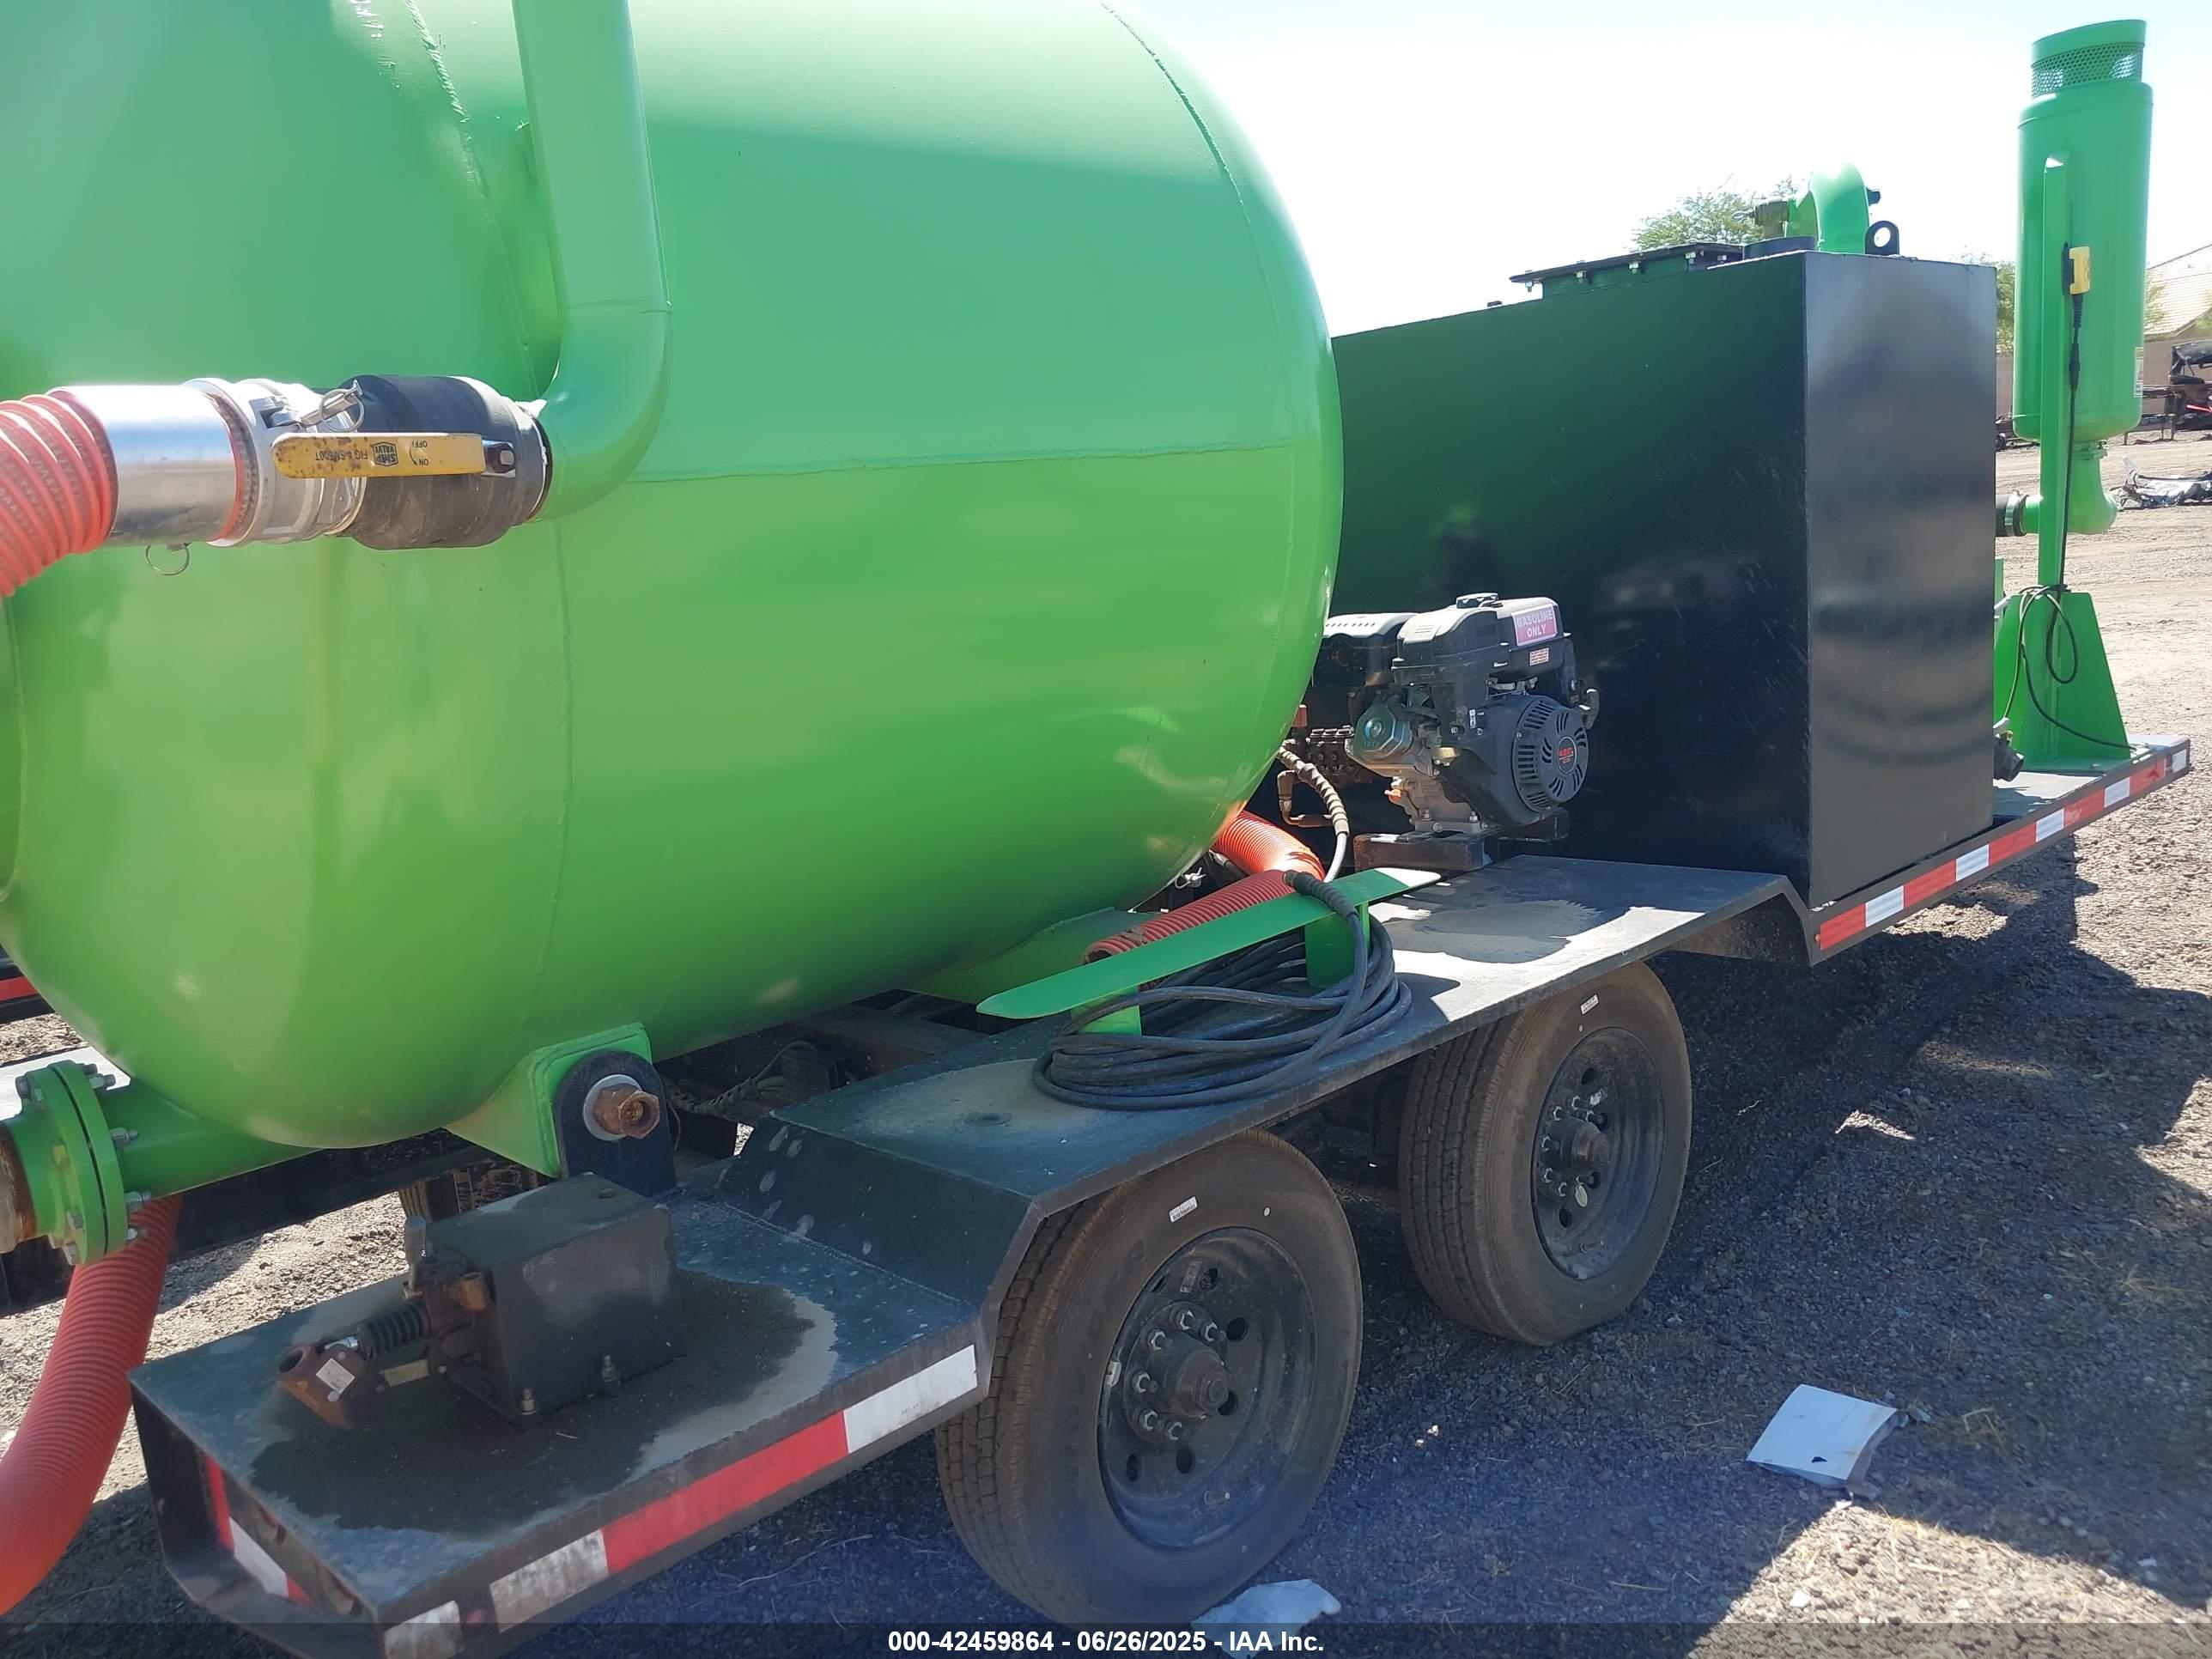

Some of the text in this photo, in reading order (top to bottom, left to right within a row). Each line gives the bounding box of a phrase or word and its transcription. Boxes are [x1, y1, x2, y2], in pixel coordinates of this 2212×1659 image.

[356, 449, 368, 459] FIG
[376, 453, 396, 463] SMP
[1516, 611, 1553, 627] GASOLINE
[1527, 624, 1547, 638] ONLY
